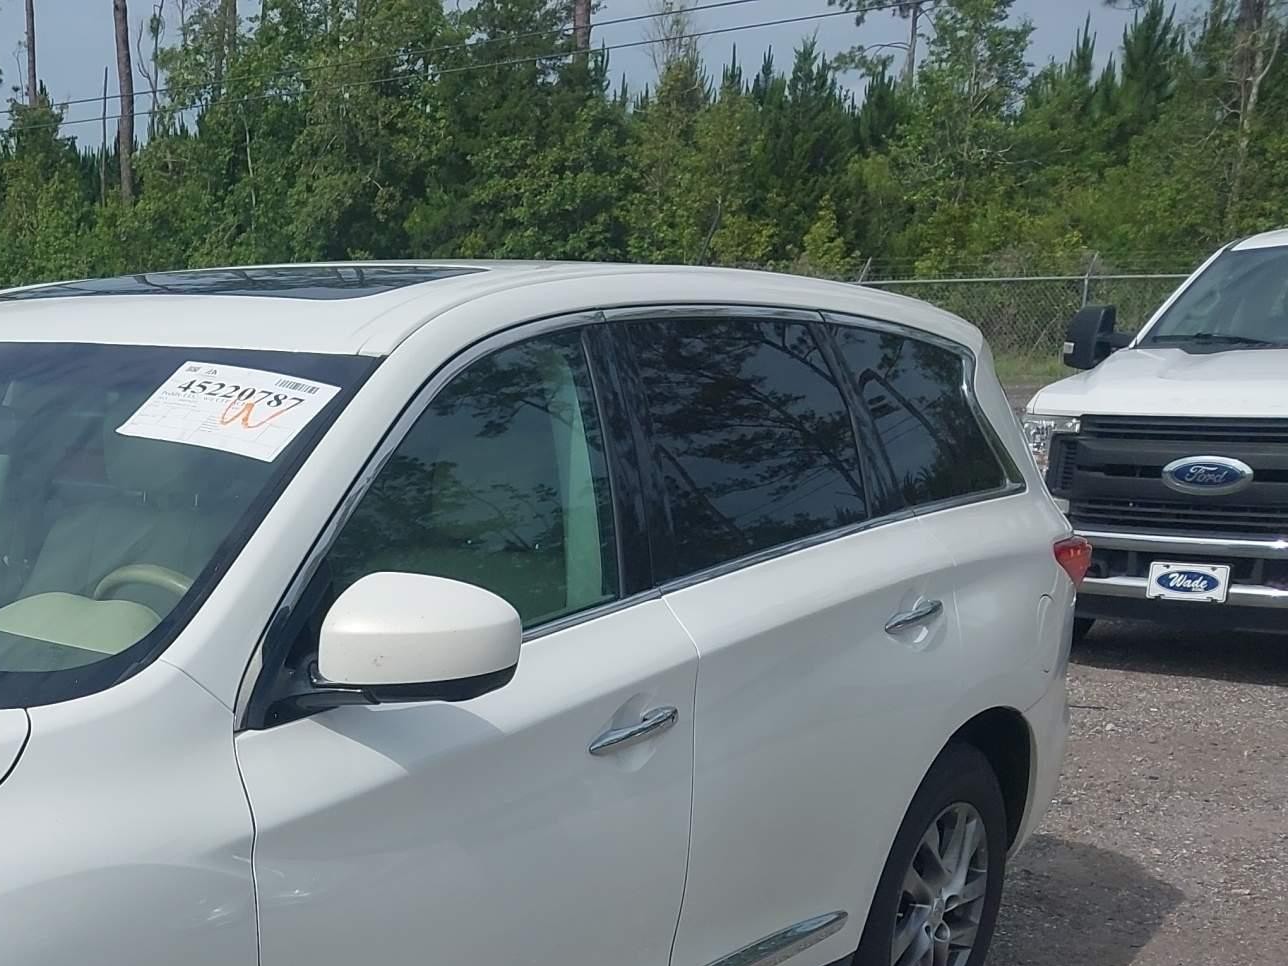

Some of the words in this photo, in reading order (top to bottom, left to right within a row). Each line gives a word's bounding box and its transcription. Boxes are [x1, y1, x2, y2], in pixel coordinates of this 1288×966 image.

[177, 379, 305, 408] 45220787
[1185, 465, 1228, 481] Ford
[1168, 572, 1208, 588] Wade
